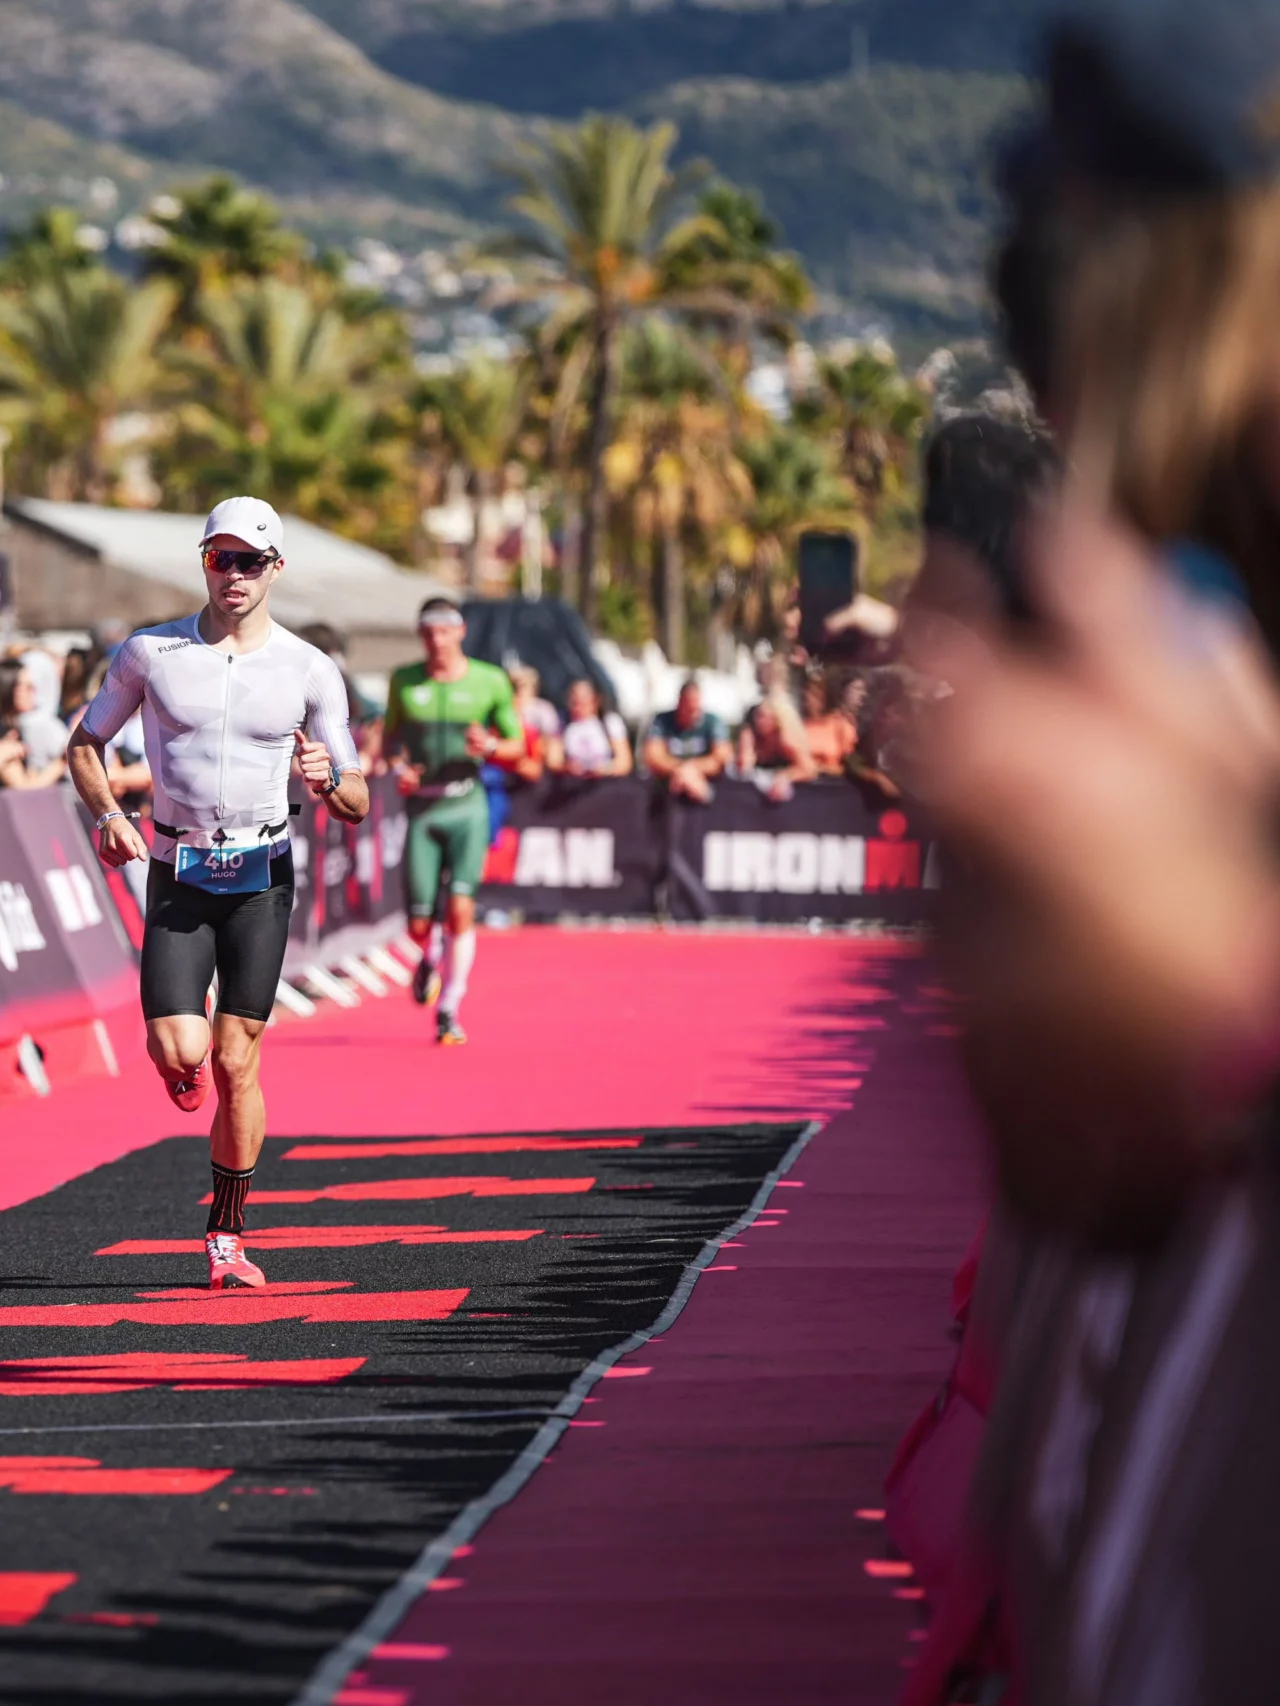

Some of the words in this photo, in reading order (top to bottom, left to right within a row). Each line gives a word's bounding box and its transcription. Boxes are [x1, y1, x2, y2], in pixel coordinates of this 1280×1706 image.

[157, 639, 193, 654] FUSION
[204, 851, 244, 870] 410
[211, 871, 237, 879] HUGO
